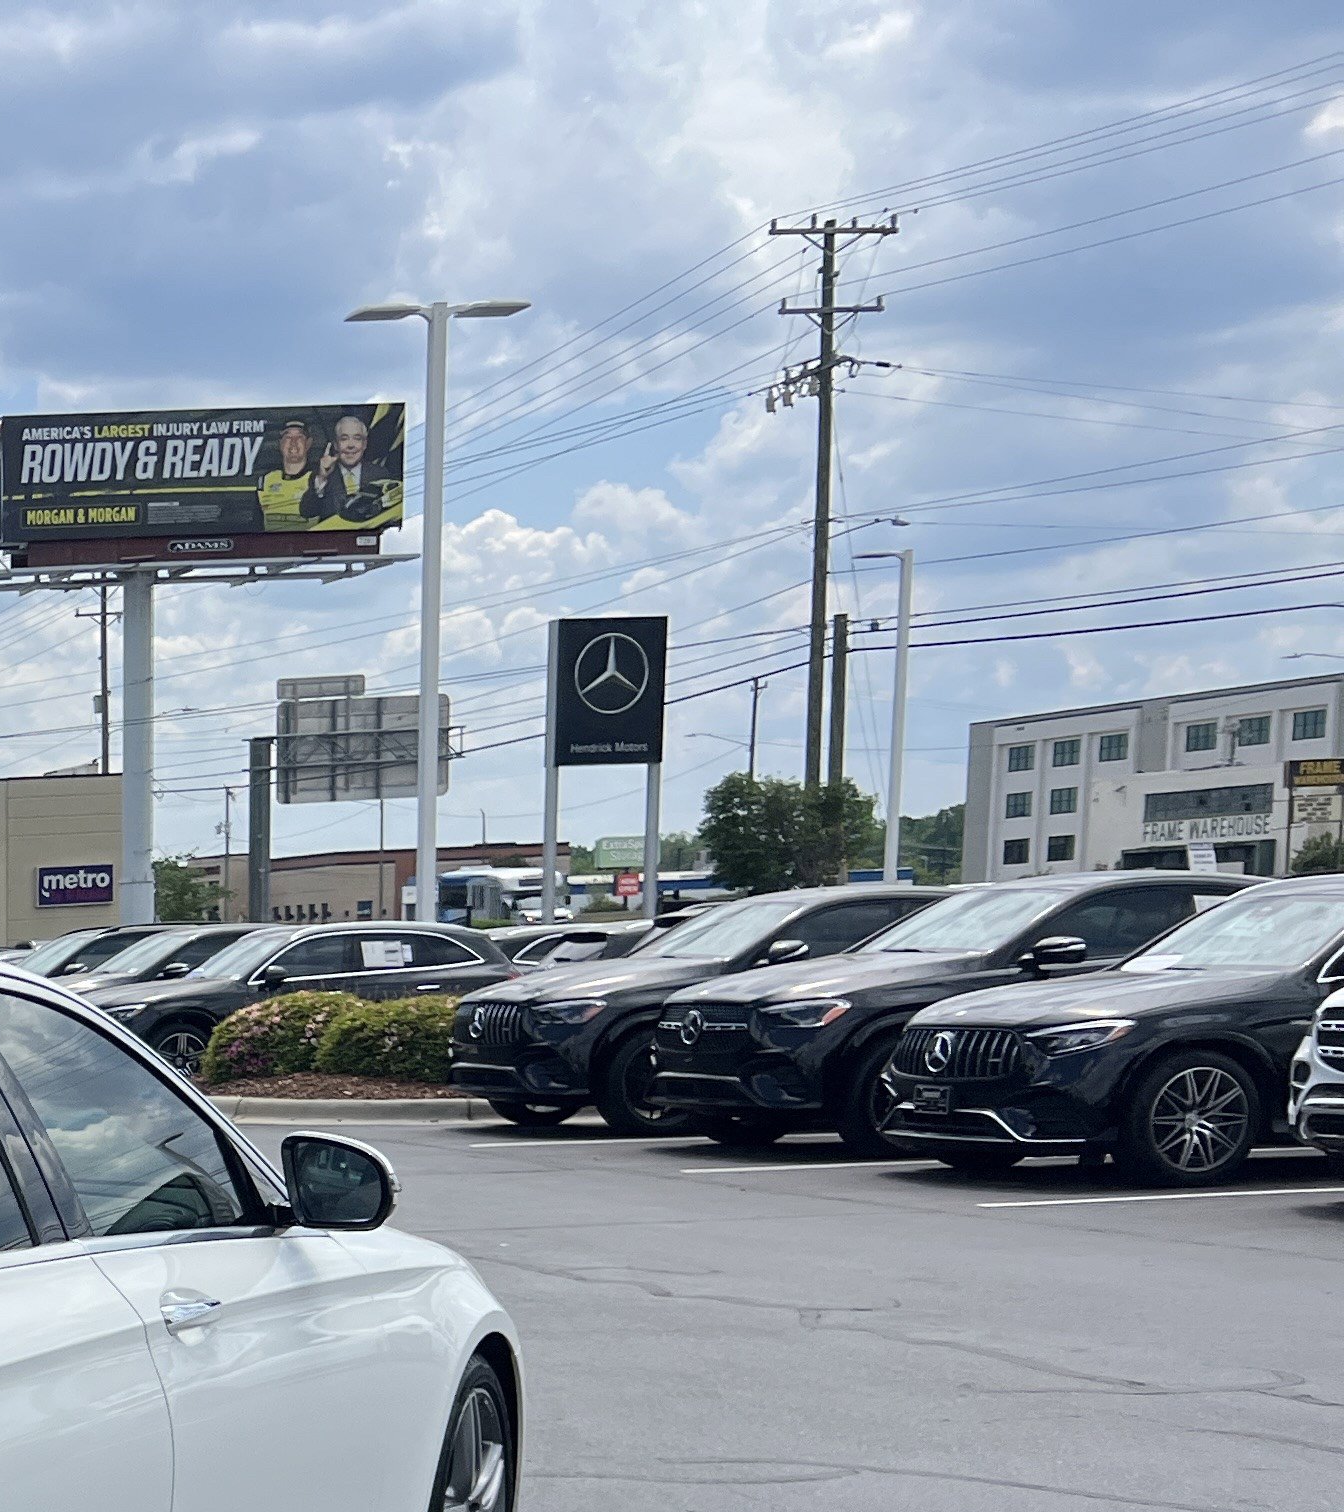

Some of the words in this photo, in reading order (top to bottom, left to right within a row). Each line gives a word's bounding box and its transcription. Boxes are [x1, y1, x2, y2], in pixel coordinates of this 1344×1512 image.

[22, 426, 91, 441] AMERICA'S
[94, 424, 150, 438] LARGEST
[153, 422, 200, 437] INJURY
[202, 421, 231, 435] LAW
[232, 420, 265, 434] FIRM
[20, 441, 135, 484] ROWDY
[135, 440, 158, 480] &
[162, 436, 264, 479] READY
[26, 509, 74, 525] MORGAN
[77, 508, 85, 524] &
[87, 506, 136, 523] MORGAN
[171, 540, 230, 551] ADAMS
[614, 741, 648, 752] Motors
[1143, 821, 1184, 841] FRAME
[1190, 813, 1271, 839] WAREHOUSE
[43, 869, 110, 890] metro
